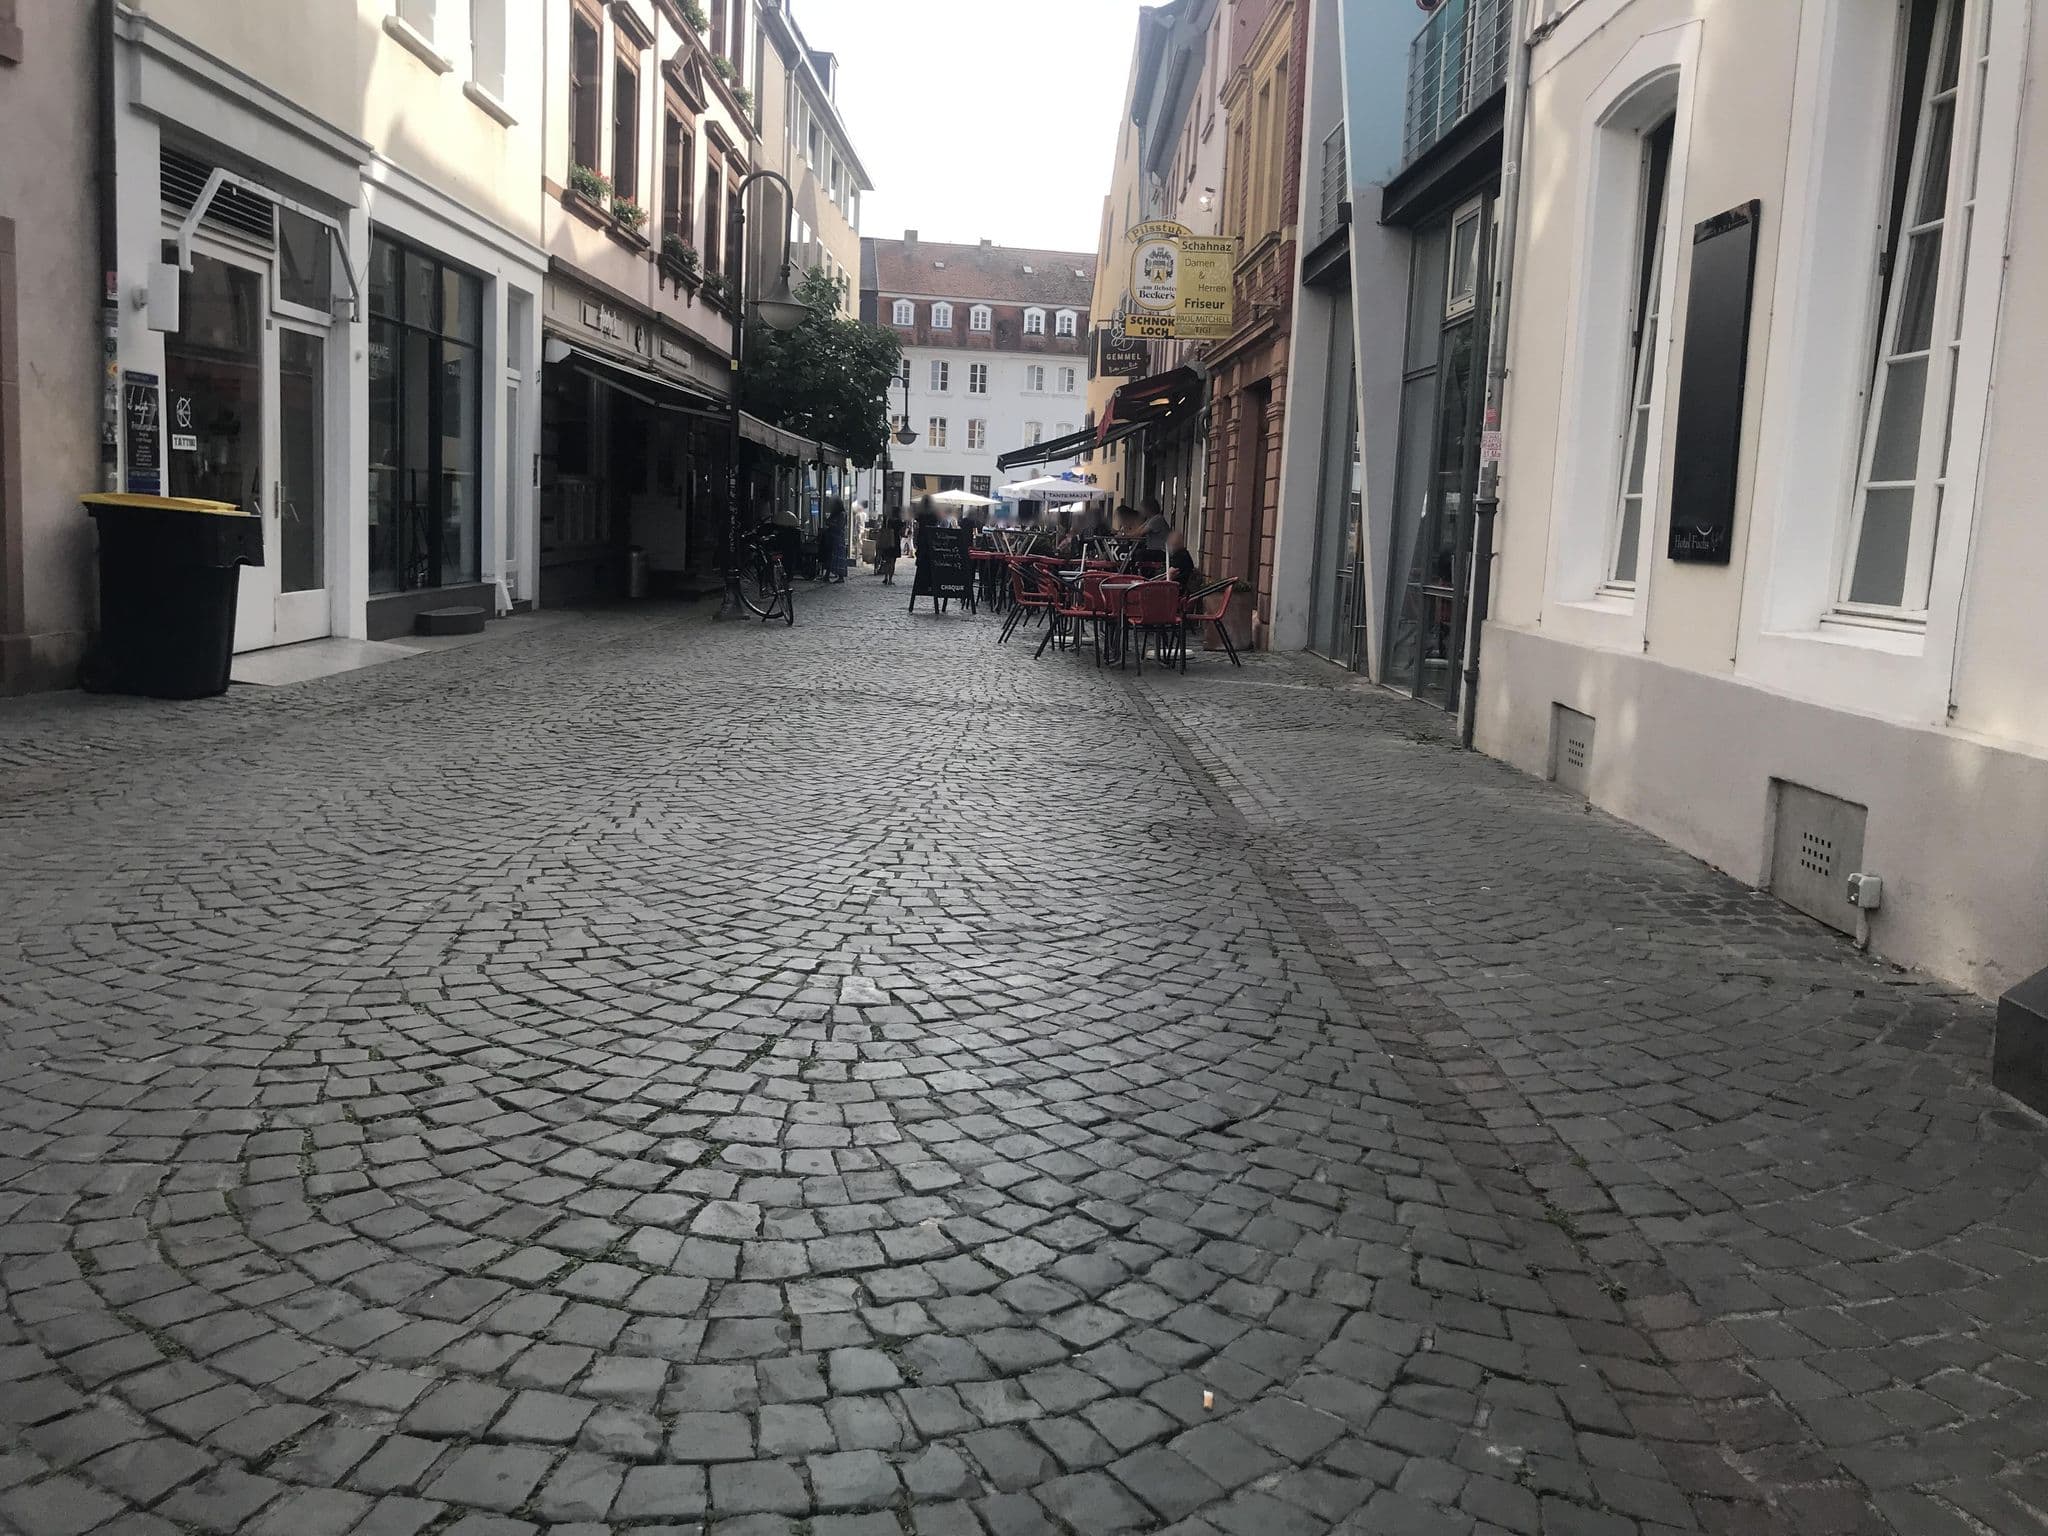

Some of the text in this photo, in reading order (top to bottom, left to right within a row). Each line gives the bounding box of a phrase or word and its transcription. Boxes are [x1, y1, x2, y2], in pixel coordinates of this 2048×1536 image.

[1181, 241, 1232, 252] Schahnaz
[1184, 258, 1216, 268] Damen
[1198, 271, 1206, 280] &
[1198, 283, 1227, 293] Herren
[1184, 298, 1226, 309] Friseur
[1176, 315, 1231, 324] PAUL MITCHELL
[1140, 327, 1170, 337] LOCH
[1194, 326, 1211, 334] TIGI
[1106, 353, 1142, 361] GEMMEL
[1675, 533, 1690, 549] Hotel
